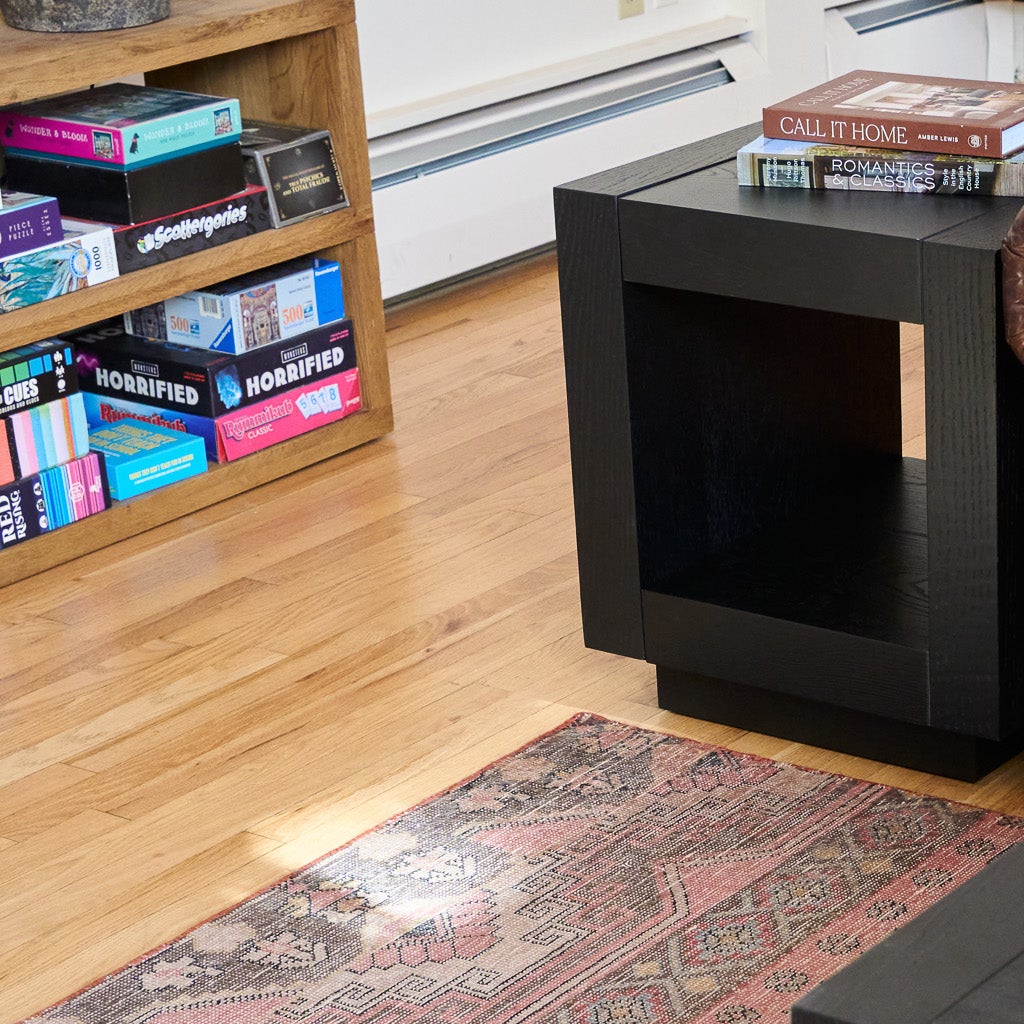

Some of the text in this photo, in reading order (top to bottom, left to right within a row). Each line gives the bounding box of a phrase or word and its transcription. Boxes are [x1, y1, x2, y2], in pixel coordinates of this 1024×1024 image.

[20, 124, 88, 142] WONDER & BLOOM
[780, 116, 908, 144] CALL IT HOME
[918, 134, 938, 142] AMBER
[832, 159, 935, 176] ROMANTICS
[958, 165, 966, 190] English
[292, 183, 309, 193] TOTAL
[832, 174, 936, 190] & CLASSICS
[8, 228, 34, 242] PUZZLE
[9, 220, 32, 232] PIECE
[154, 204, 247, 250] Scattergories
[92, 246, 102, 270] 1000
[170, 316, 190, 332] 500
[282, 304, 303, 326] 500
[246, 346, 344, 398] HORRIFIED
[4, 378, 39, 406] CUES
[95, 367, 199, 406] HORRIFIED
[299, 388, 337, 410] 5 6 7 8
[223, 399, 294, 442] Rummikub
[248, 424, 274, 440] CLASSIC
[0, 495, 16, 544] RED
[10, 490, 26, 540] RISING
